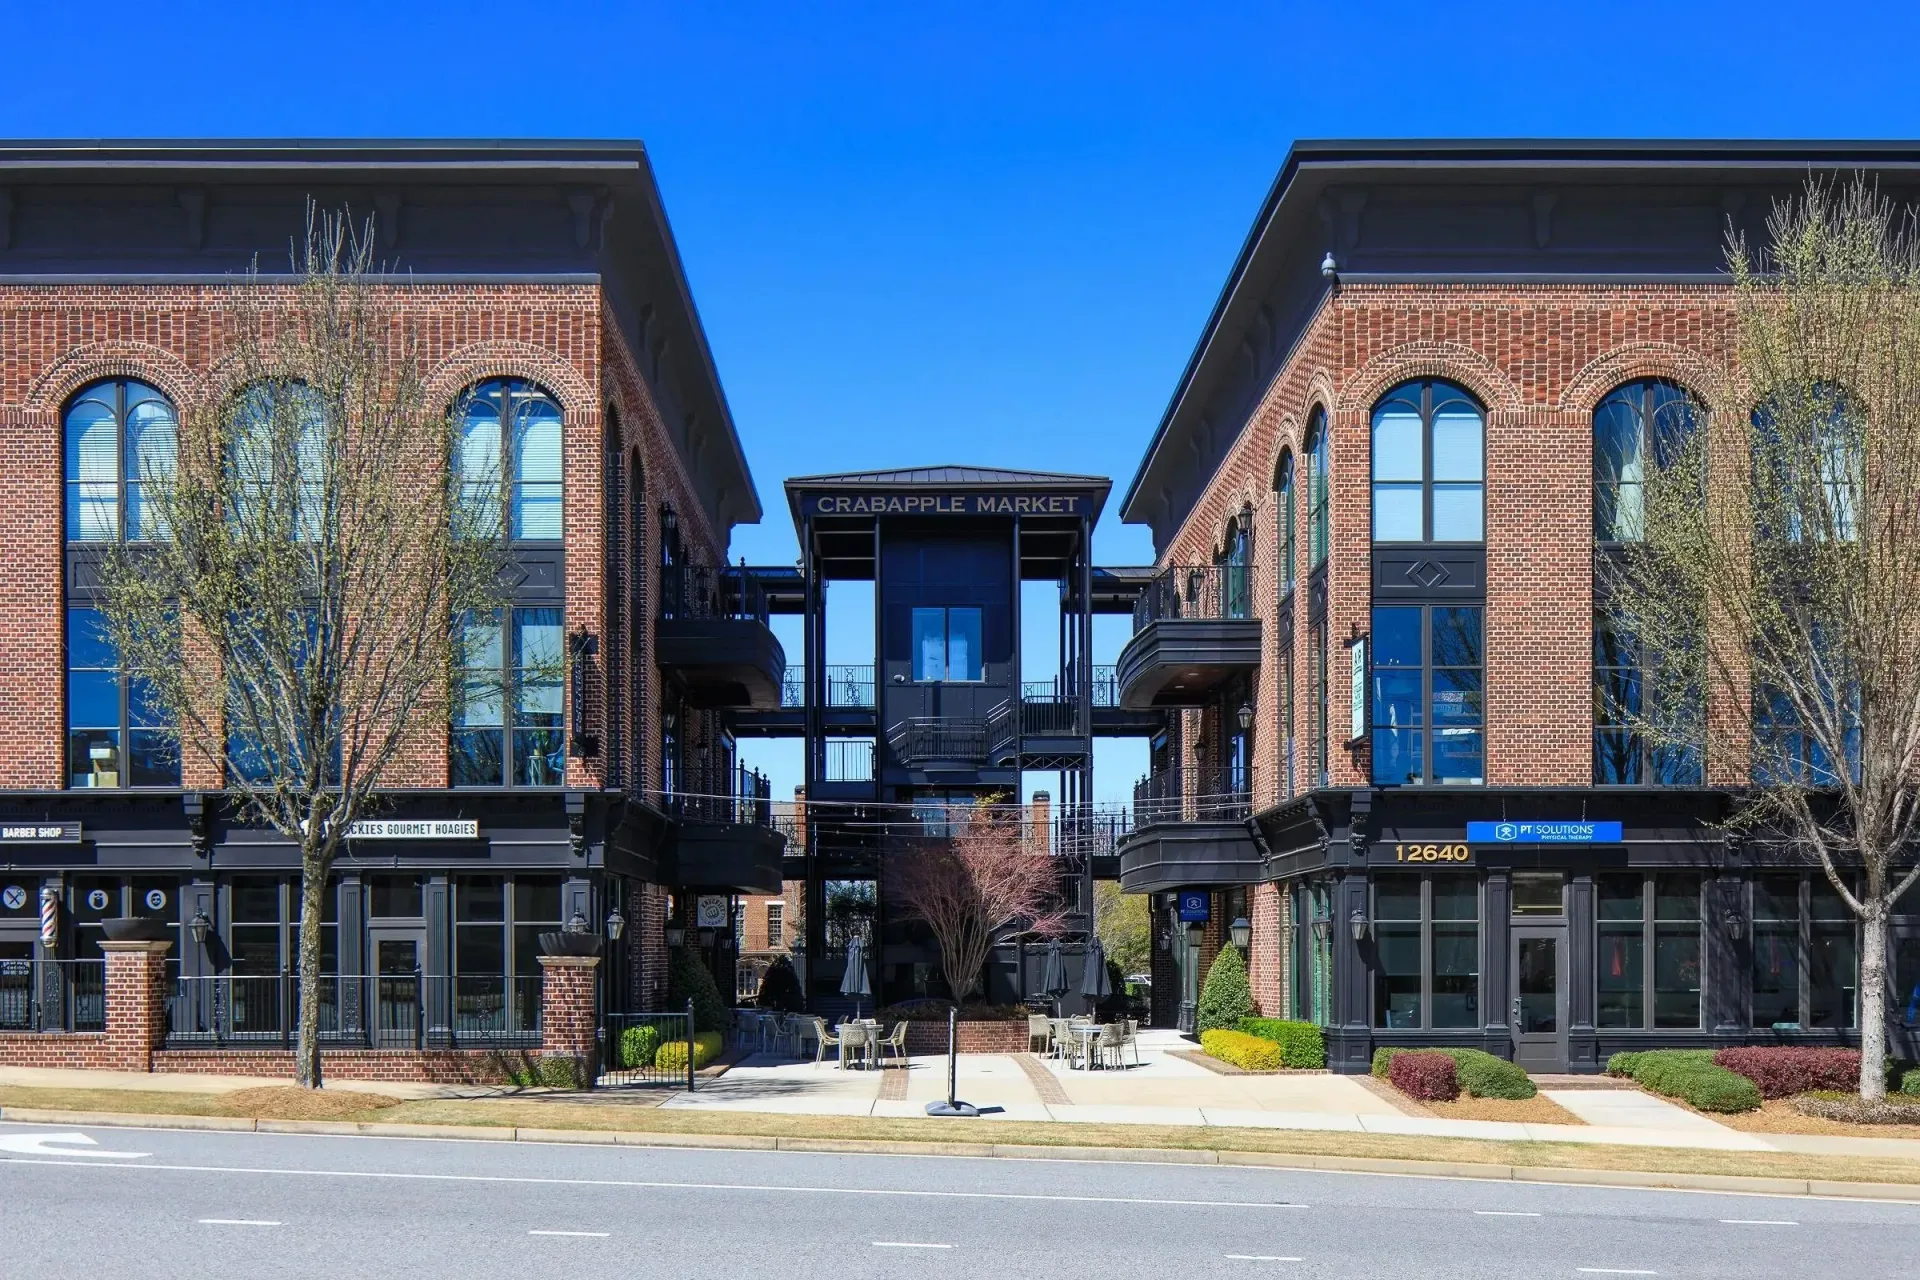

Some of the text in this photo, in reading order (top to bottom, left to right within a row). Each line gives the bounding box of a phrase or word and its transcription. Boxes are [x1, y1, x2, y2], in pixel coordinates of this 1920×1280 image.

[817, 496, 1079, 513] CRABAPPLE MARKET
[2, 827, 62, 838] BARBER SHOP
[387, 823, 431, 835] GOURMET
[435, 823, 476, 835] HOAGIES
[1520, 825, 1593, 834] PT SOLUTIONS
[1396, 844, 1468, 861] 12640
